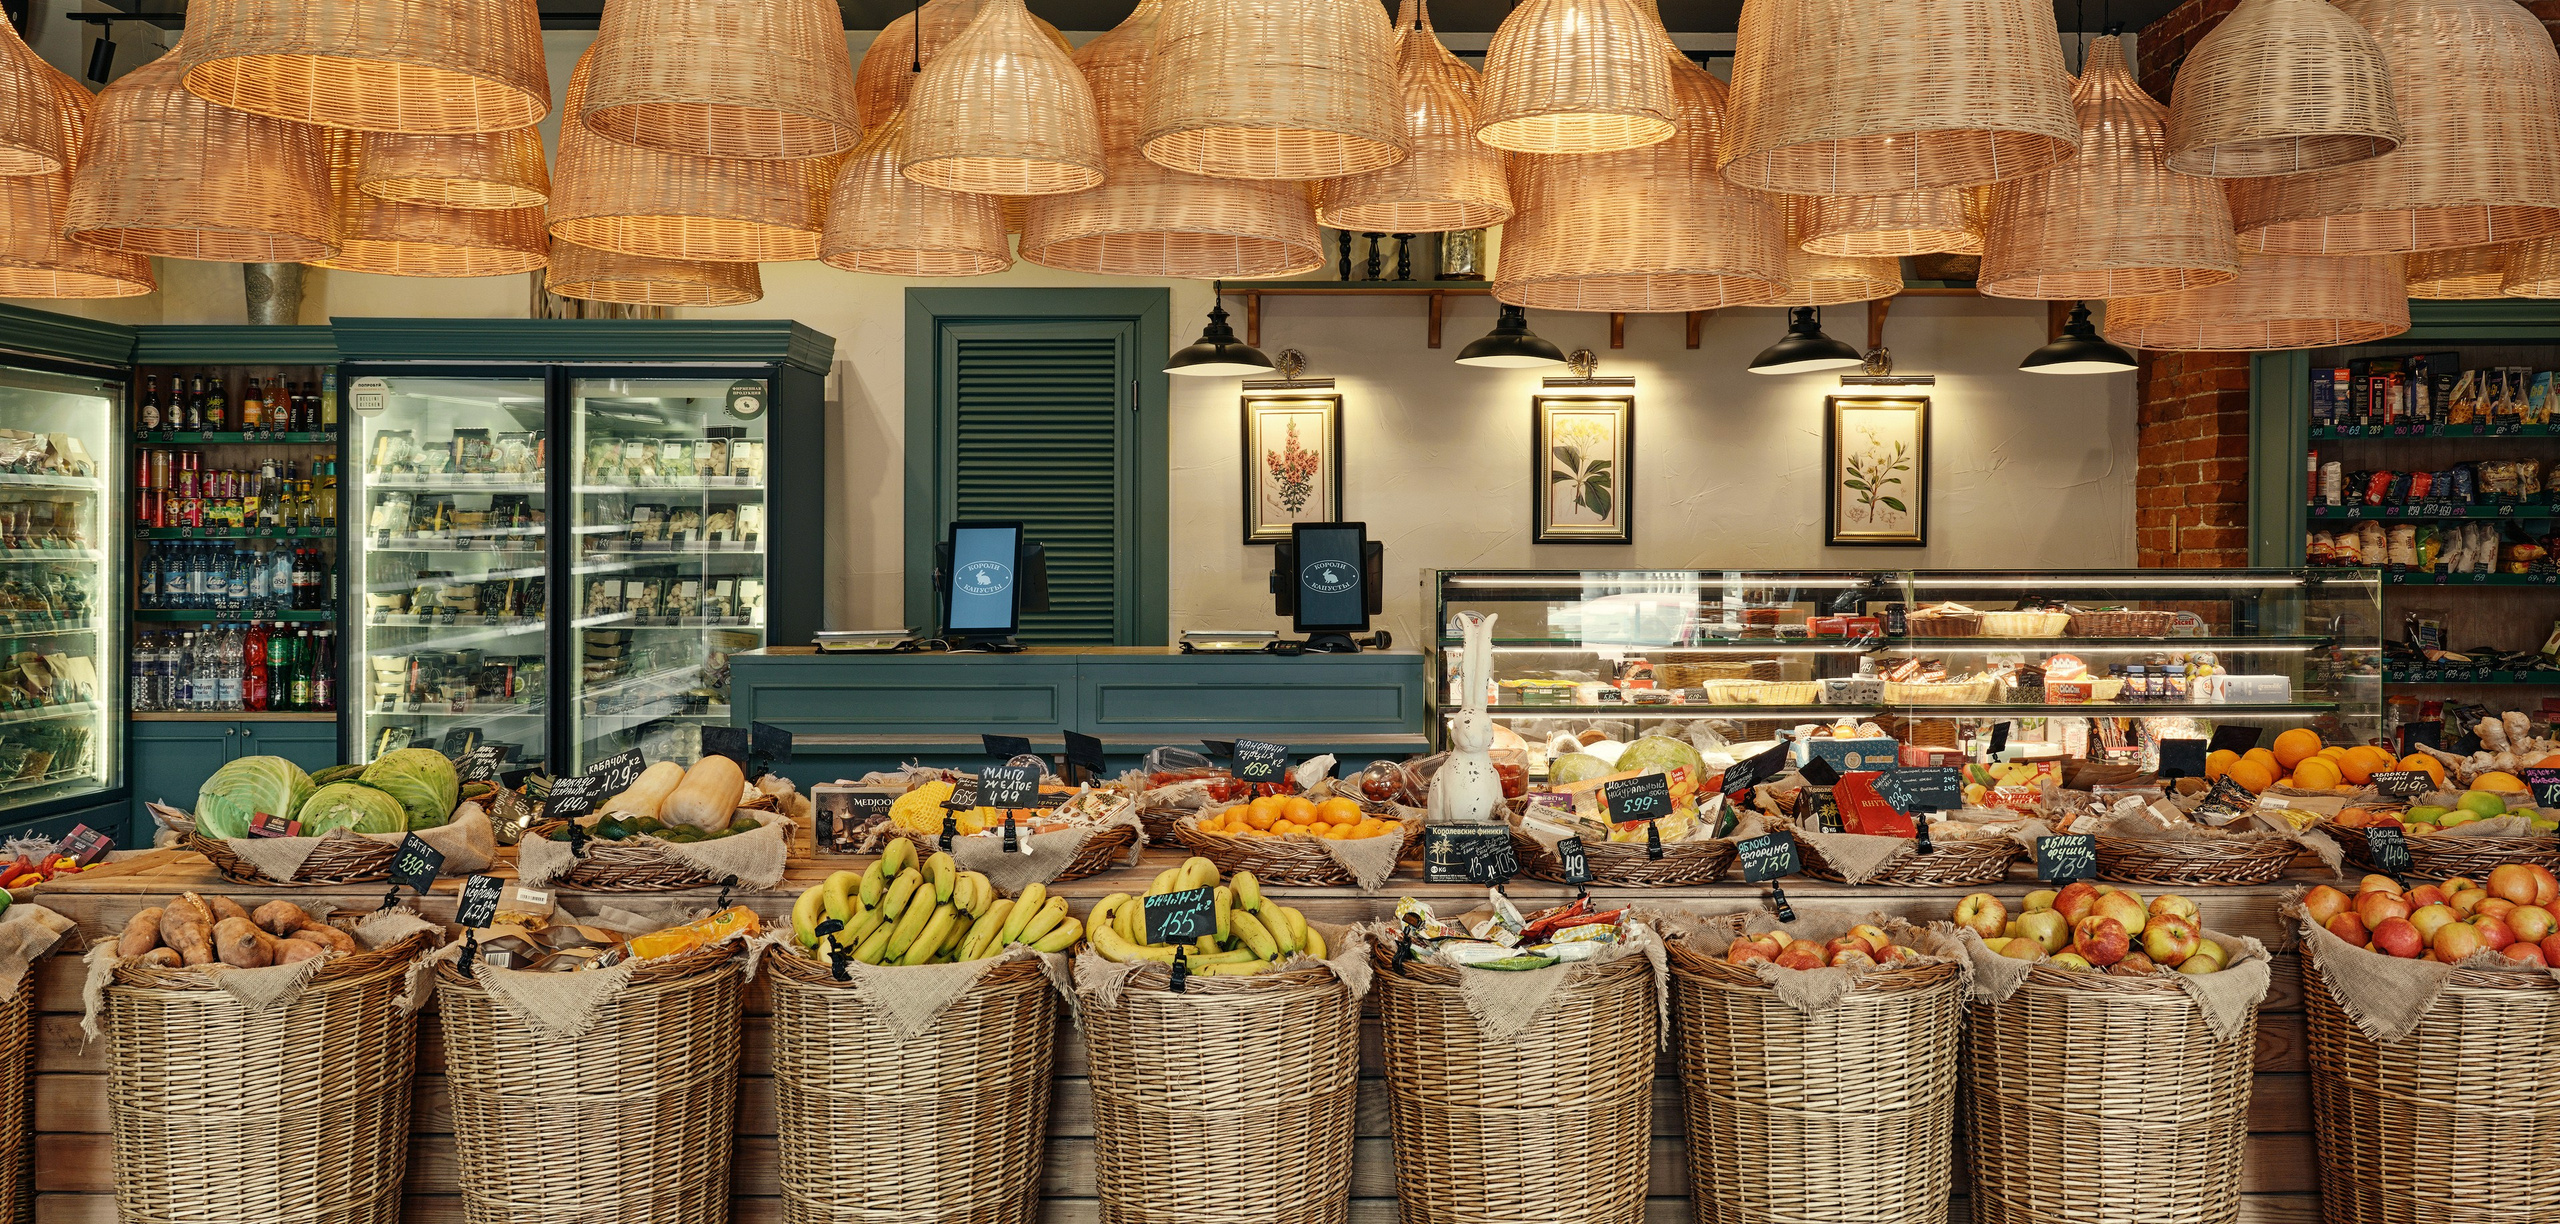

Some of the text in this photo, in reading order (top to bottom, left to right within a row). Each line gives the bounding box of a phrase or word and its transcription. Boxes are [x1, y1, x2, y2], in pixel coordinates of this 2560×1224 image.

[968, 563, 1001, 572] КОРОЛИ
[1314, 562, 1347, 570] КОРОЛИ
[963, 584, 1003, 593] КАПУСТЫ
[1311, 582, 1350, 591] КАПУСТЫ
[588, 754, 628, 775] КАБАЧОК
[982, 767, 1024, 780] МАНГО
[985, 780, 1032, 792] ЖЕЛТОЕ
[950, 788, 978, 806] 659
[989, 790, 1020, 806] 499
[1478, 828, 1504, 836] финики
[408, 836, 434, 858] БАТАТ
[1738, 836, 1770, 854] ЯБЛОКО
[2041, 836, 2086, 850] ЯБЛОКО
[1740, 842, 1789, 862] ФЛОРИНА
[2047, 846, 2086, 860] ФУШИ
[1566, 855, 1584, 876] 49
[1759, 852, 1790, 874] 139
[1158, 908, 1195, 936] 155
